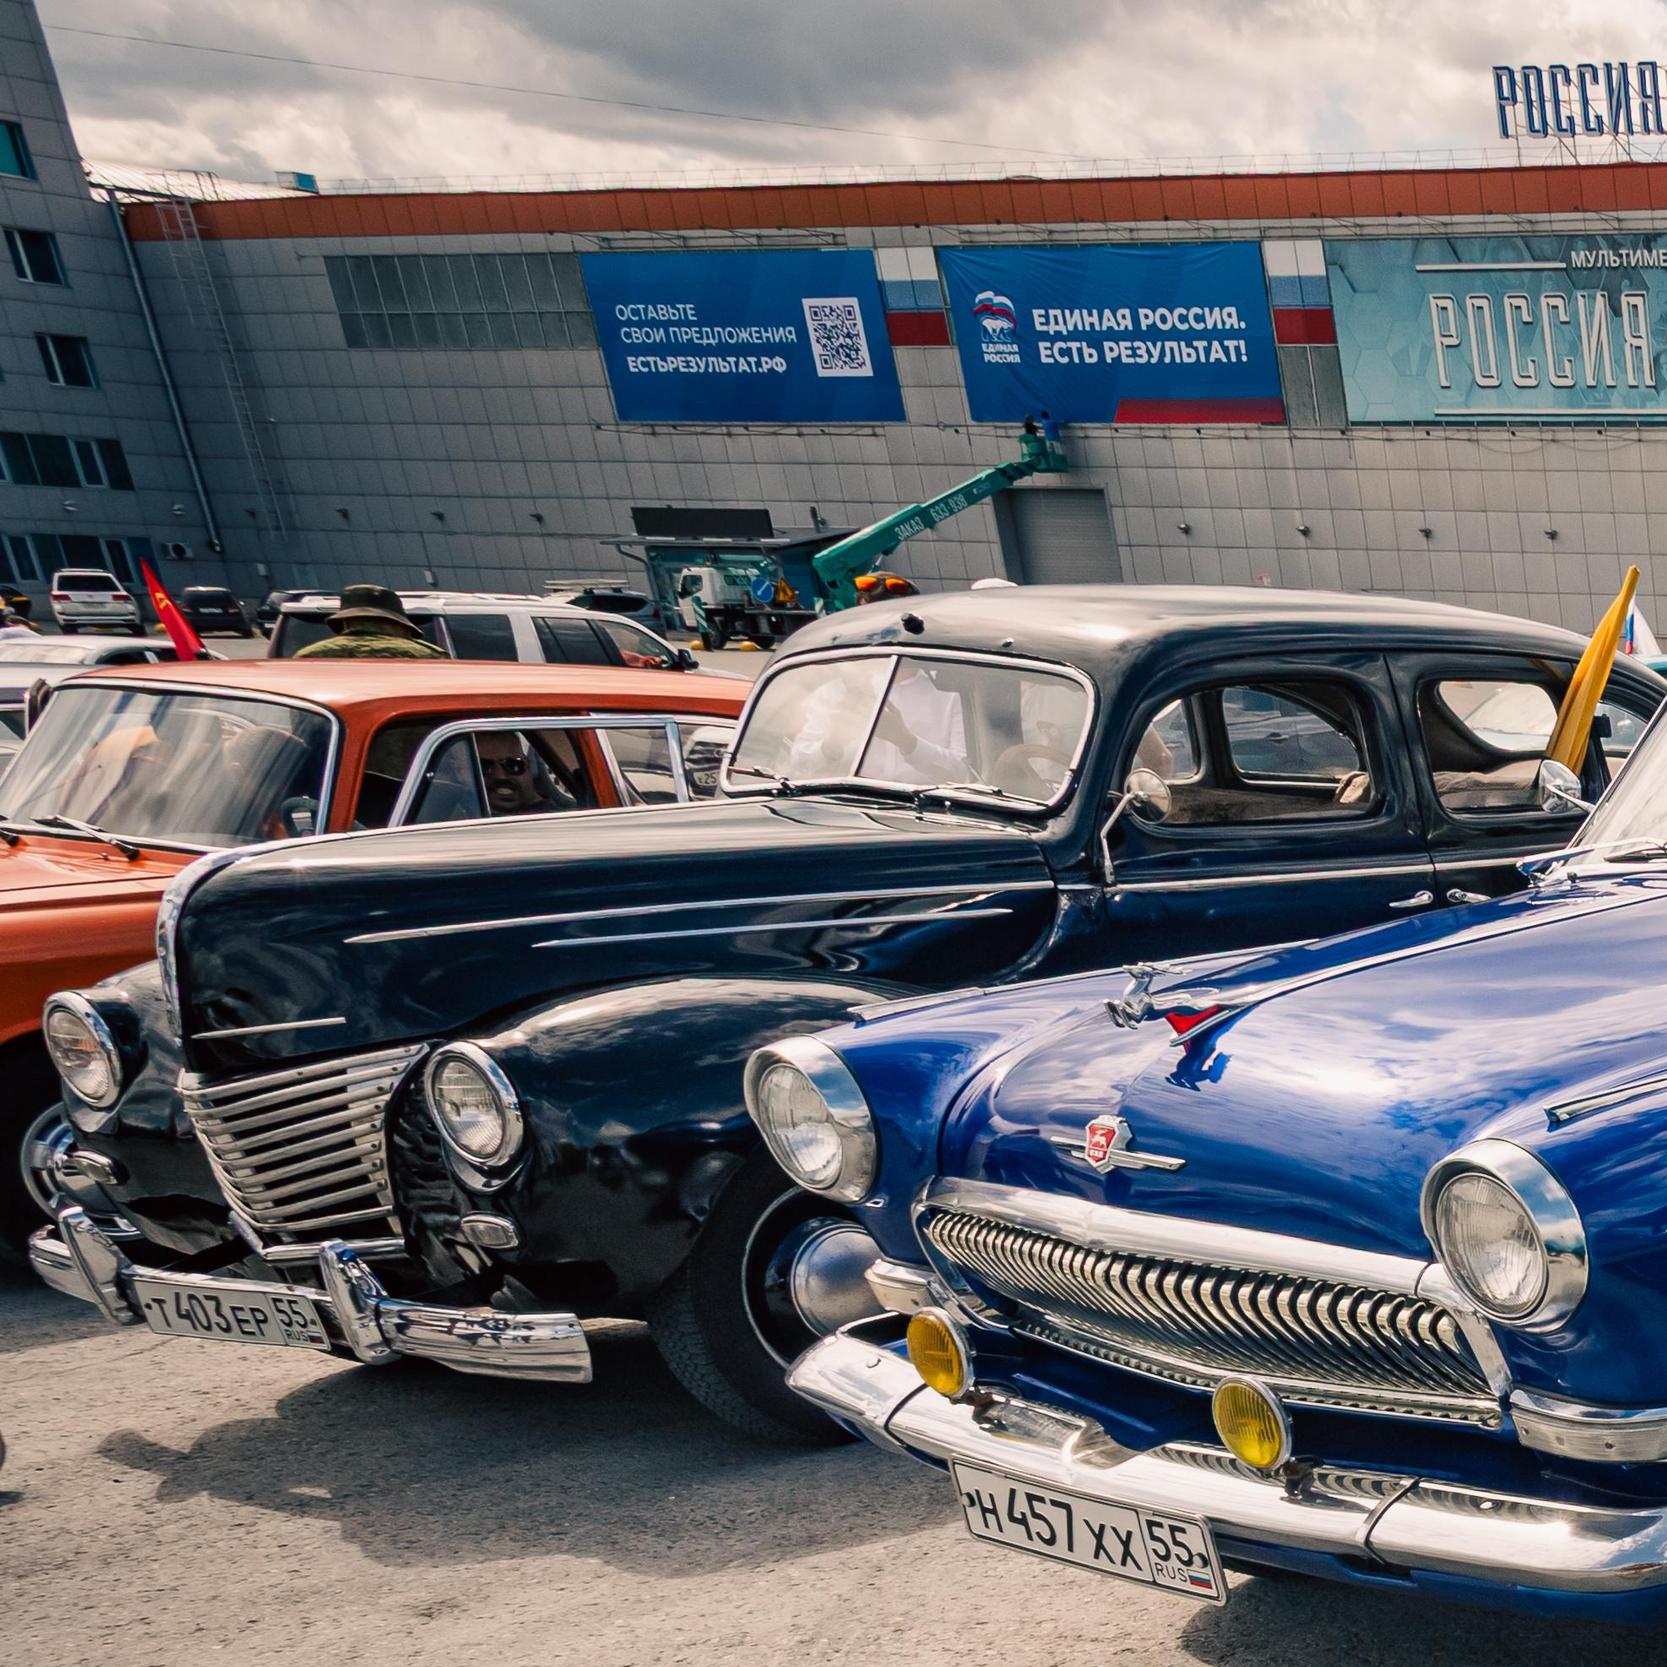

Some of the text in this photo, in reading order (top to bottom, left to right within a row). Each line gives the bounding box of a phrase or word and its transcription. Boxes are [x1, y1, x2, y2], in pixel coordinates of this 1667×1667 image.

[1492, 61, 1666, 139] РОССИЯ
[615, 303, 698, 322] ОСТАВЬТЕ
[1032, 306, 1247, 336] ЕДИНАЯ РОССИЯ.
[620, 326, 797, 346] СВОИ ПРЕДЛОЖЕНИЯ
[981, 343, 1019, 353] ЕДИНАЯ
[1428, 290, 1656, 388] РОССИЯ
[983, 353, 1021, 363] РОССИЯ
[1039, 339, 1249, 365] ЕСТЬ РЕЗУЛЬТАТ!
[626, 356, 788, 375] ЕСТЬРЕЗУЛЬТАТ.РФ
[894, 516, 925, 541] ЗАКАЗ
[271, 1297, 308, 1329] 55
[1145, 1518, 1194, 1567] 55
[1155, 1561, 1188, 1583] RUS
